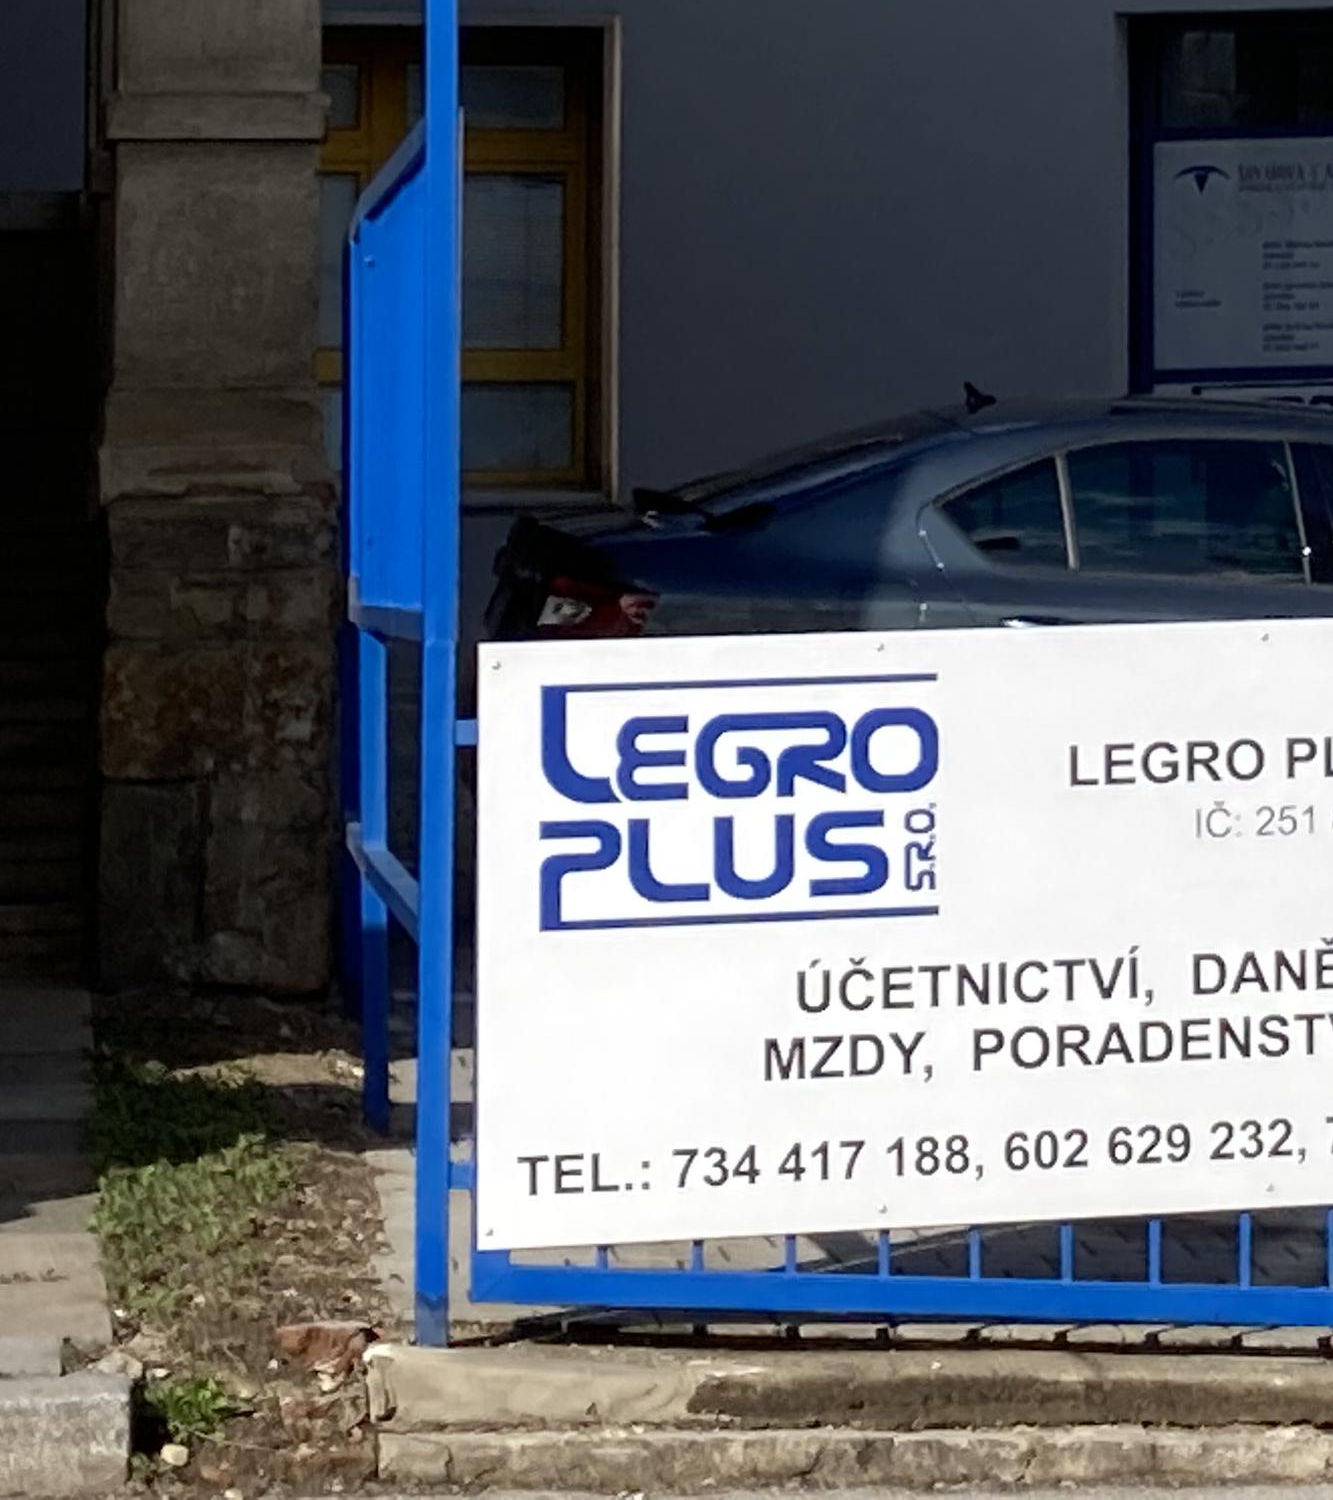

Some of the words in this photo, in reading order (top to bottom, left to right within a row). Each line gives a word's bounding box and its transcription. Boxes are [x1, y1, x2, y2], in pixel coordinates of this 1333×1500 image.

[540, 676, 939, 804] LEGRO
[1070, 738, 1265, 787] LEGRO
[1196, 799, 1243, 839] IČ:
[1256, 804, 1315, 837] 251
[540, 809, 890, 932] PLUS
[797, 947, 1154, 1014] ÚČETNICTVÍ,
[764, 1028, 933, 1083] MZDY,
[517, 1153, 650, 1196] TEL.:
[672, 1144, 761, 1188] 734
[778, 1140, 865, 1182] 417
[887, 1134, 984, 1180] 188,
[1004, 1128, 1088, 1171] 602
[1108, 1123, 1191, 1166] 629
[1209, 1118, 1306, 1162] 232,
